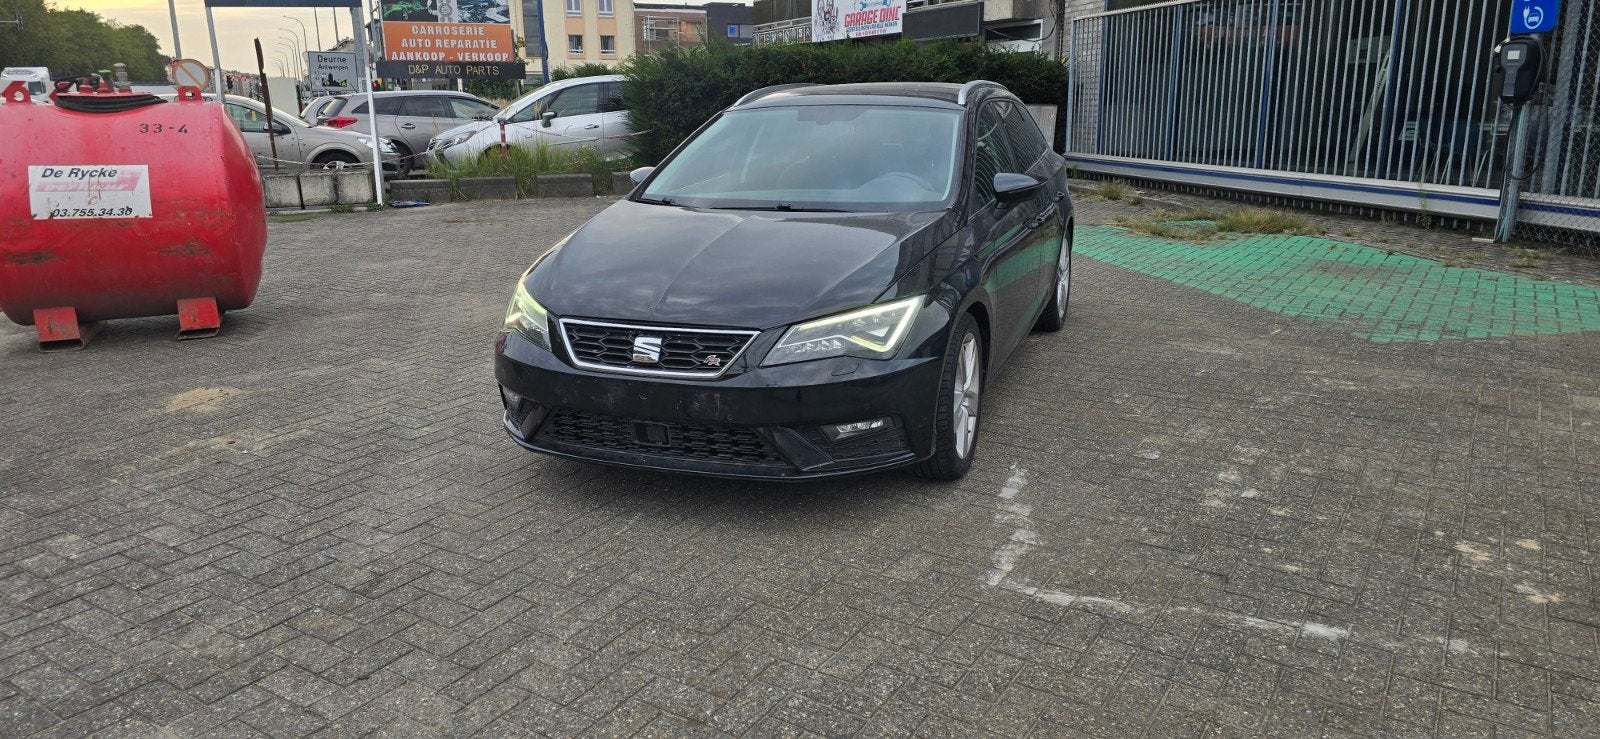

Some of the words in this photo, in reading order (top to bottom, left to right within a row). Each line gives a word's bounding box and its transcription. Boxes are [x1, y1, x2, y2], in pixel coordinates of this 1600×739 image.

[844, 10, 879, 28] GARAGE
[401, 39, 431, 48] AUTO
[317, 55, 347, 64] Deurne
[391, 52, 446, 61] AANKOOP
[457, 52, 509, 62] VERKOOP
[408, 65, 429, 74] D&P
[435, 65, 461, 75] AUTO
[466, 66, 500, 76] PARTS
[41, 168, 63, 178] De
[68, 167, 118, 180] Rycke
